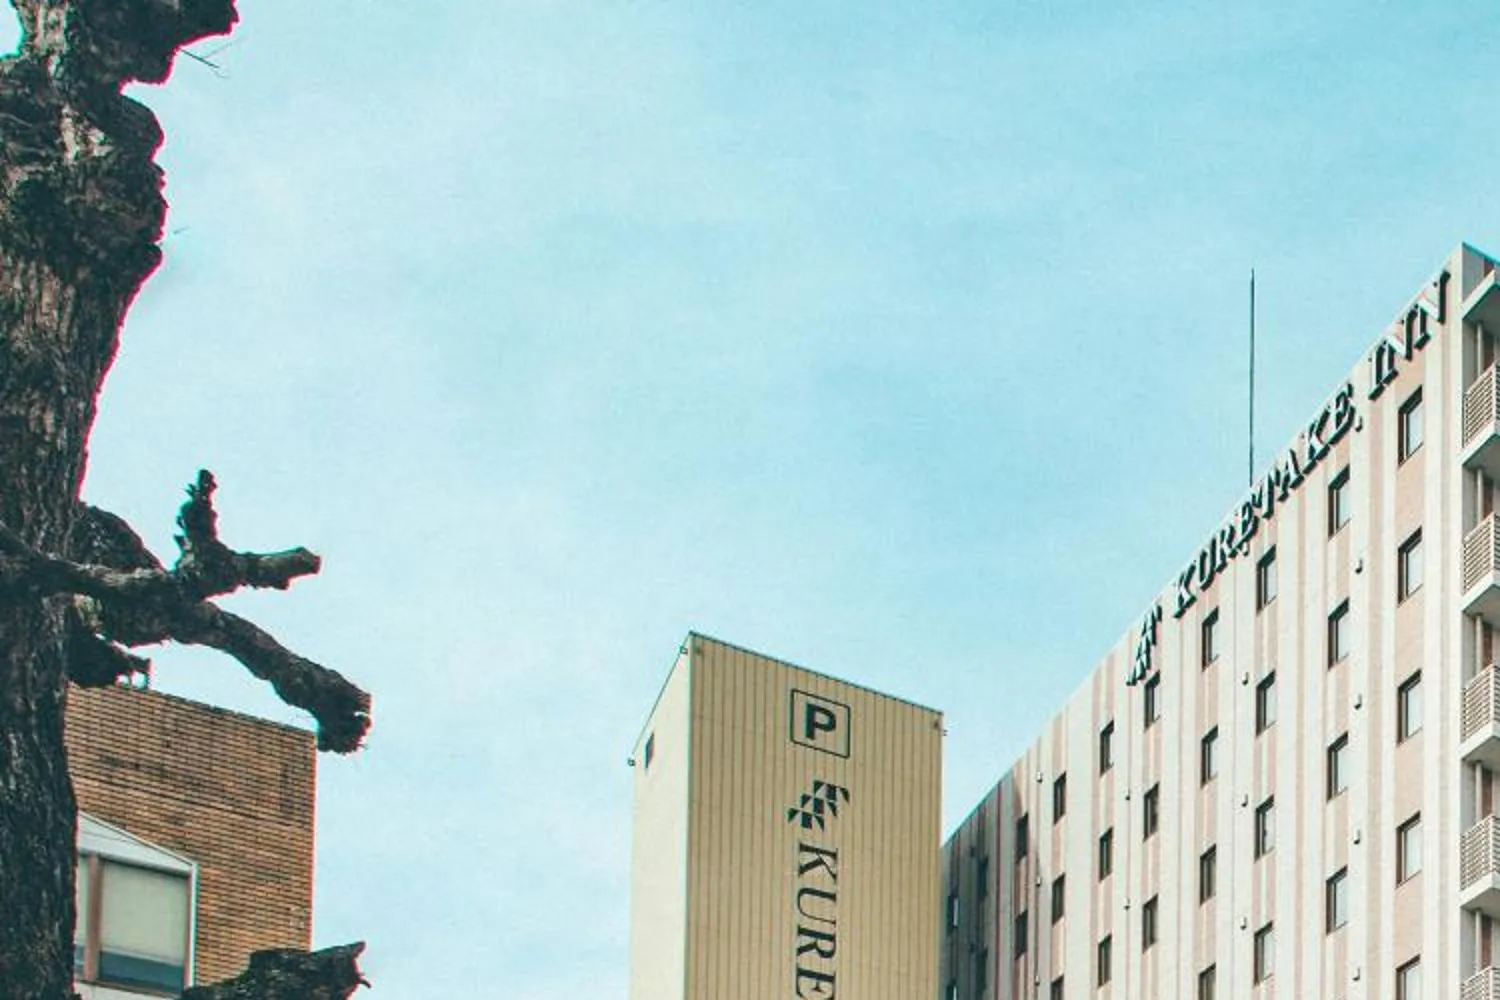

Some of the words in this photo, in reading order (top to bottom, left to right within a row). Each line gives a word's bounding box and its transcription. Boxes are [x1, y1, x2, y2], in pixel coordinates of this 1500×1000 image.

[1173, 383, 1356, 619] KURETAKE
[1368, 270, 1452, 400] INN
[806, 702, 836, 739] P
